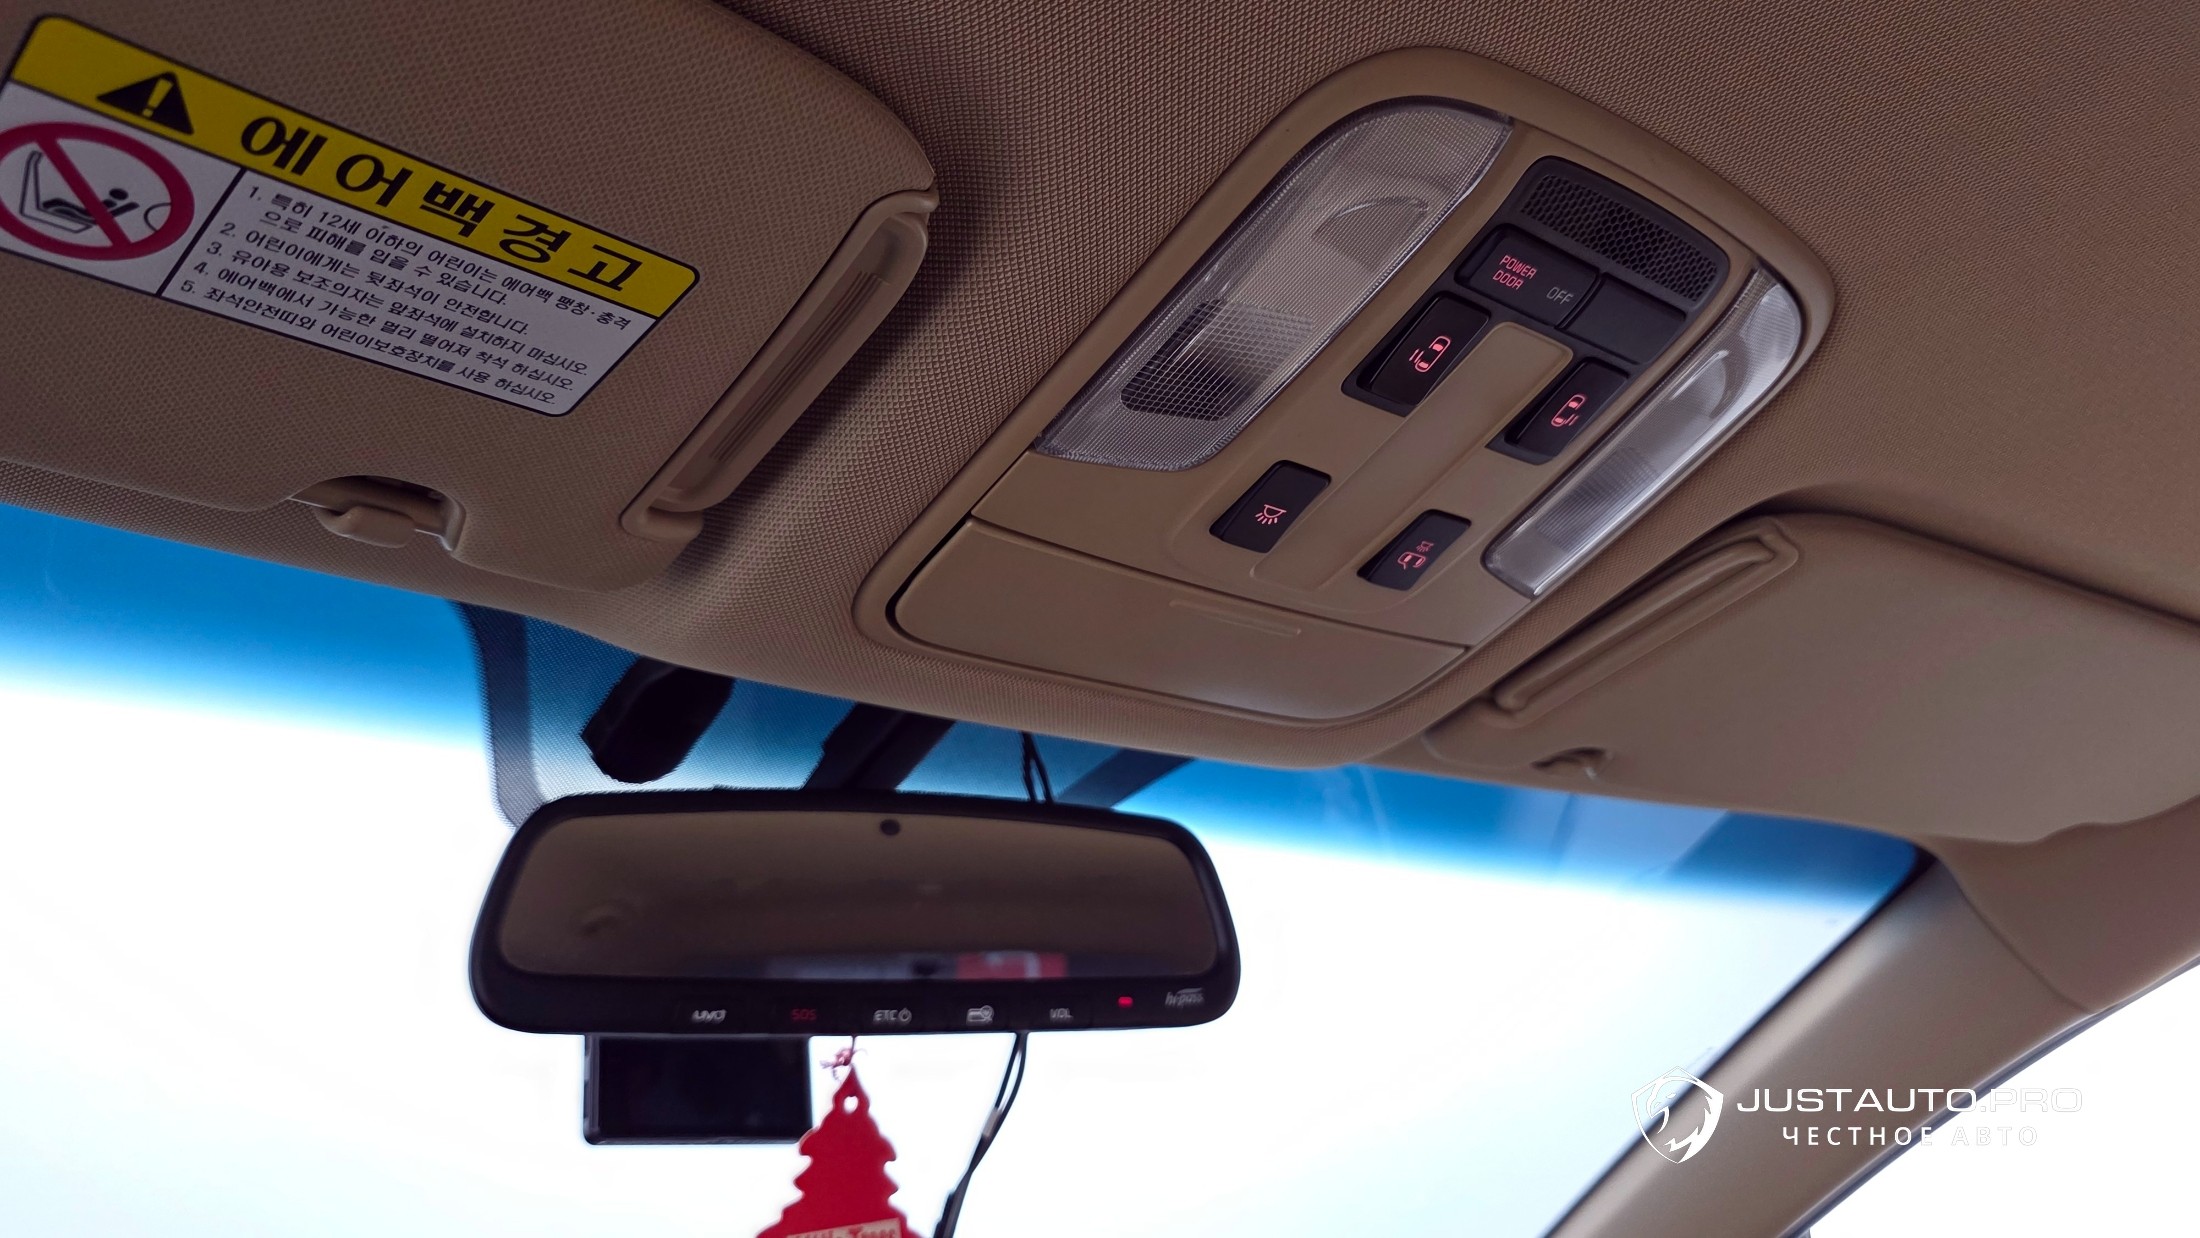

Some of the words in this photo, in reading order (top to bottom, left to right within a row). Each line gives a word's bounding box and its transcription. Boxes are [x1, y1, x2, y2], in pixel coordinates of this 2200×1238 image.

[248, 186, 261, 201] 1.
[270, 192, 314, 218] 특히
[319, 211, 362, 234] 12세
[365, 227, 424, 257] 이하의
[427, 249, 498, 284] 어린이는
[501, 276, 554, 302] 에어백
[259, 209, 302, 234] 으로
[305, 226, 367, 256] 피해를
[369, 248, 410, 272] 입을
[413, 264, 433, 278] 수
[436, 271, 507, 306] 있습니다.
[1499, 254, 1538, 279] POWER
[206, 240, 222, 257] 3.
[231, 249, 291, 278] 유아용
[292, 269, 385, 309] 보조의자는
[387, 301, 460, 334] 앞좌석에
[459, 324, 526, 354] 설치하지
[526, 346, 588, 376] 마십시오.
[220, 222, 236, 238] 2.
[246, 229, 361, 279] 어린이에게는
[364, 270, 440, 305] 뒷좌석이
[443, 296, 528, 336] 안전합니다.
[1492, 270, 1524, 290] DOOR
[1546, 286, 1574, 305] OFF
[180, 279, 195, 294] 5.
[203, 287, 317, 331] 좌석안전띠와
[321, 323, 456, 373] 어린이보호장치를
[455, 365, 491, 384] 사용
[494, 378, 556, 405] 하십시오.
[193, 261, 209, 276] 4.
[217, 267, 315, 308] 에어백에서
[317, 300, 376, 327] 가능한
[380, 319, 417, 340] 멀리
[418, 332, 472, 358] 떨어져
[475, 351, 510, 370] 착석
[511, 362, 574, 391] 하십시오.
[792, 1008, 817, 1021] SOS
[873, 1009, 898, 1023] ETC
[1050, 1007, 1074, 1020] VOL
